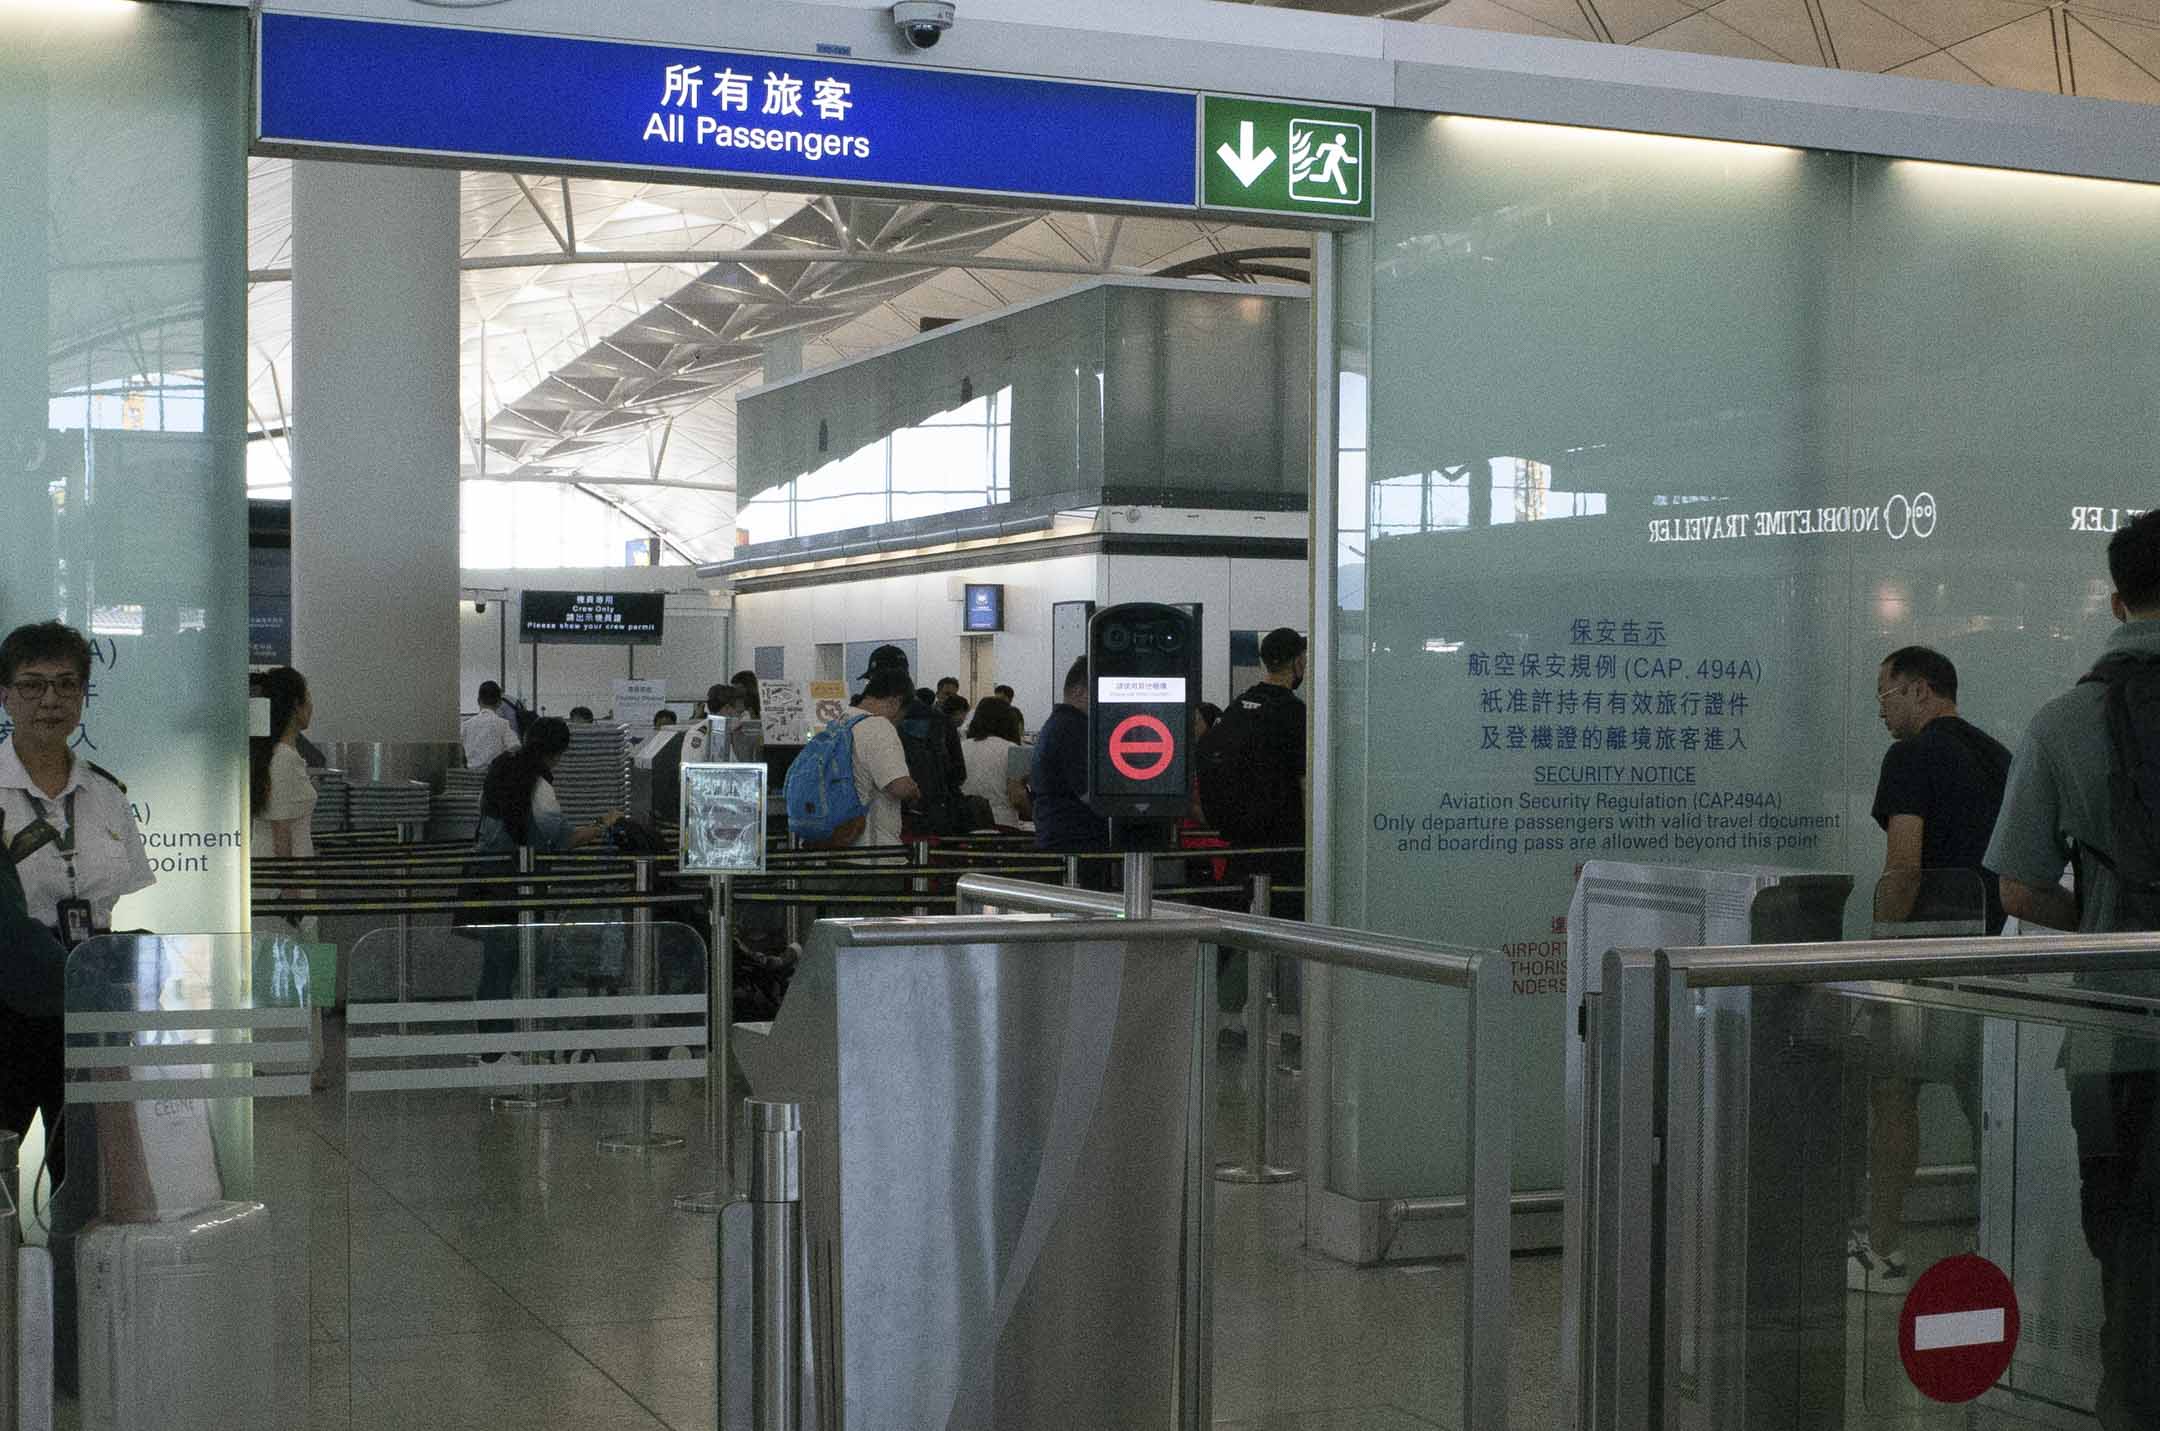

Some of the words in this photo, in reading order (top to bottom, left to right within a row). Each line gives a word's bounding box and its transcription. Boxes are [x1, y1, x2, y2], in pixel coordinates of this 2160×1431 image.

[660, 64, 853, 121] 所有旅客
[643, 112, 684, 143] All
[697, 116, 870, 160] Passengers
[595, 605, 615, 613] Only
[628, 623, 655, 631] permit
[1570, 618, 1667, 644] 保安告示
[1468, 653, 1616, 679] 航空保安規例
[1624, 657, 1690, 683] (CAP.
[1697, 658, 1762, 684] 494A)
[1480, 724, 1748, 752] 及登機證的離境旅客進入
[1535, 765, 1625, 783] SECURITY
[1632, 766, 1697, 783] NOTICE
[1439, 792, 1513, 809] Aviation
[1519, 792, 1590, 812] Security
[1597, 792, 1686, 812] Regulation
[1374, 813, 1416, 834] Only
[1422, 813, 1509, 833] departure
[1515, 816, 1614, 834] passengers
[1619, 813, 1655, 830] with
[1661, 812, 1701, 829] valid
[1707, 813, 1752, 829] travel
[1759, 812, 1840, 829] document
[138, 830, 242, 848] ocument
[1399, 834, 1431, 851] and
[1438, 834, 1517, 854] boarding
[1524, 837, 1563, 854] pass
[1570, 837, 1596, 850] are
[1602, 833, 1668, 850] allowed
[1675, 833, 1737, 853] beyond
[1742, 832, 1772, 849] this
[1777, 833, 1819, 851] point
[1511, 959, 1567, 976] THORIS
[1512, 977, 1567, 994] NDERS
